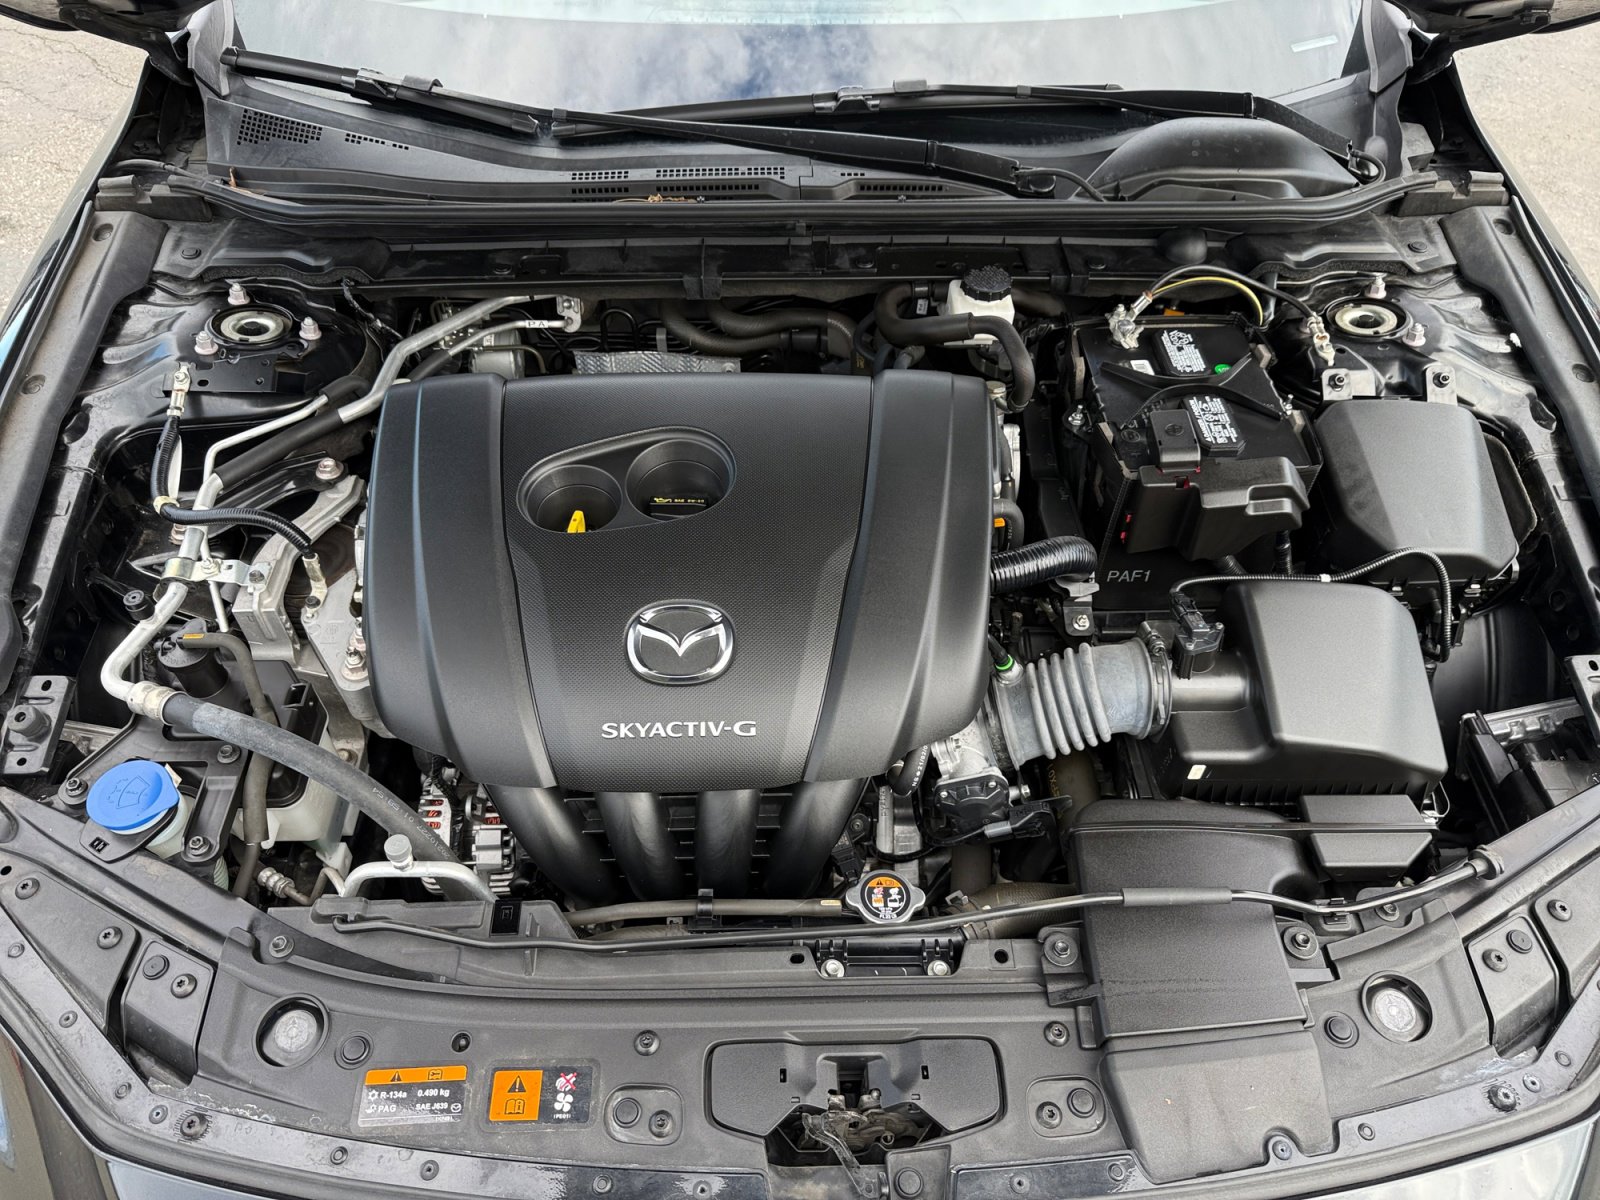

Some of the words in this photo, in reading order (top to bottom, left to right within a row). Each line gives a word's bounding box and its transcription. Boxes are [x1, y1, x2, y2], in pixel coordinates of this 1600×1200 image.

[1106, 569, 1151, 583] PAF1
[601, 720, 757, 739] SKYACTIV-G
[380, 1090, 407, 1099] R-134a
[417, 1089, 438, 1097] 0.490
[439, 1088, 450, 1097] kg
[378, 1104, 397, 1113] PAG
[431, 1102, 449, 1110] J639
